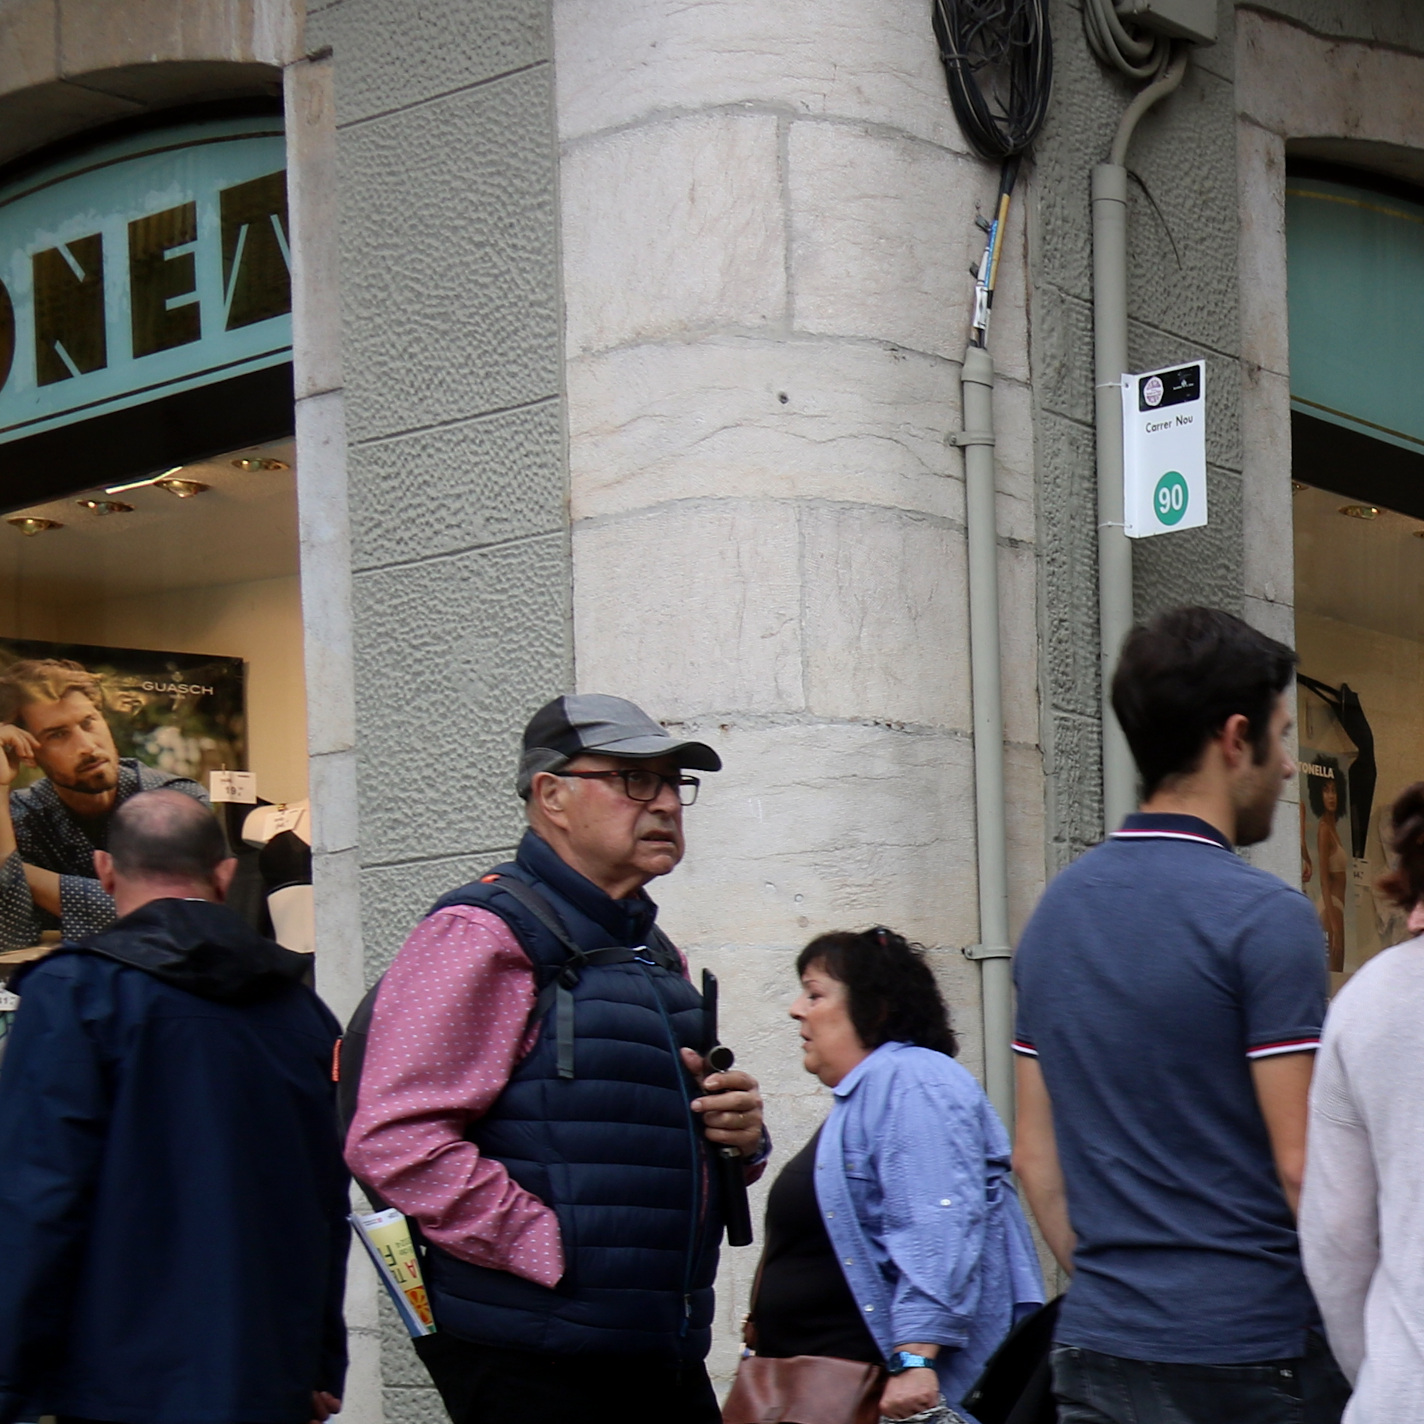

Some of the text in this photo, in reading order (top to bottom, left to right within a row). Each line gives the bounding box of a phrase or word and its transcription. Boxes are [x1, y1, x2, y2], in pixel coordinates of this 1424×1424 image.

[1145, 415, 1194, 434] Carrer Nou
[1158, 483, 1184, 514] 90
[142, 681, 214, 696] GUASCH
